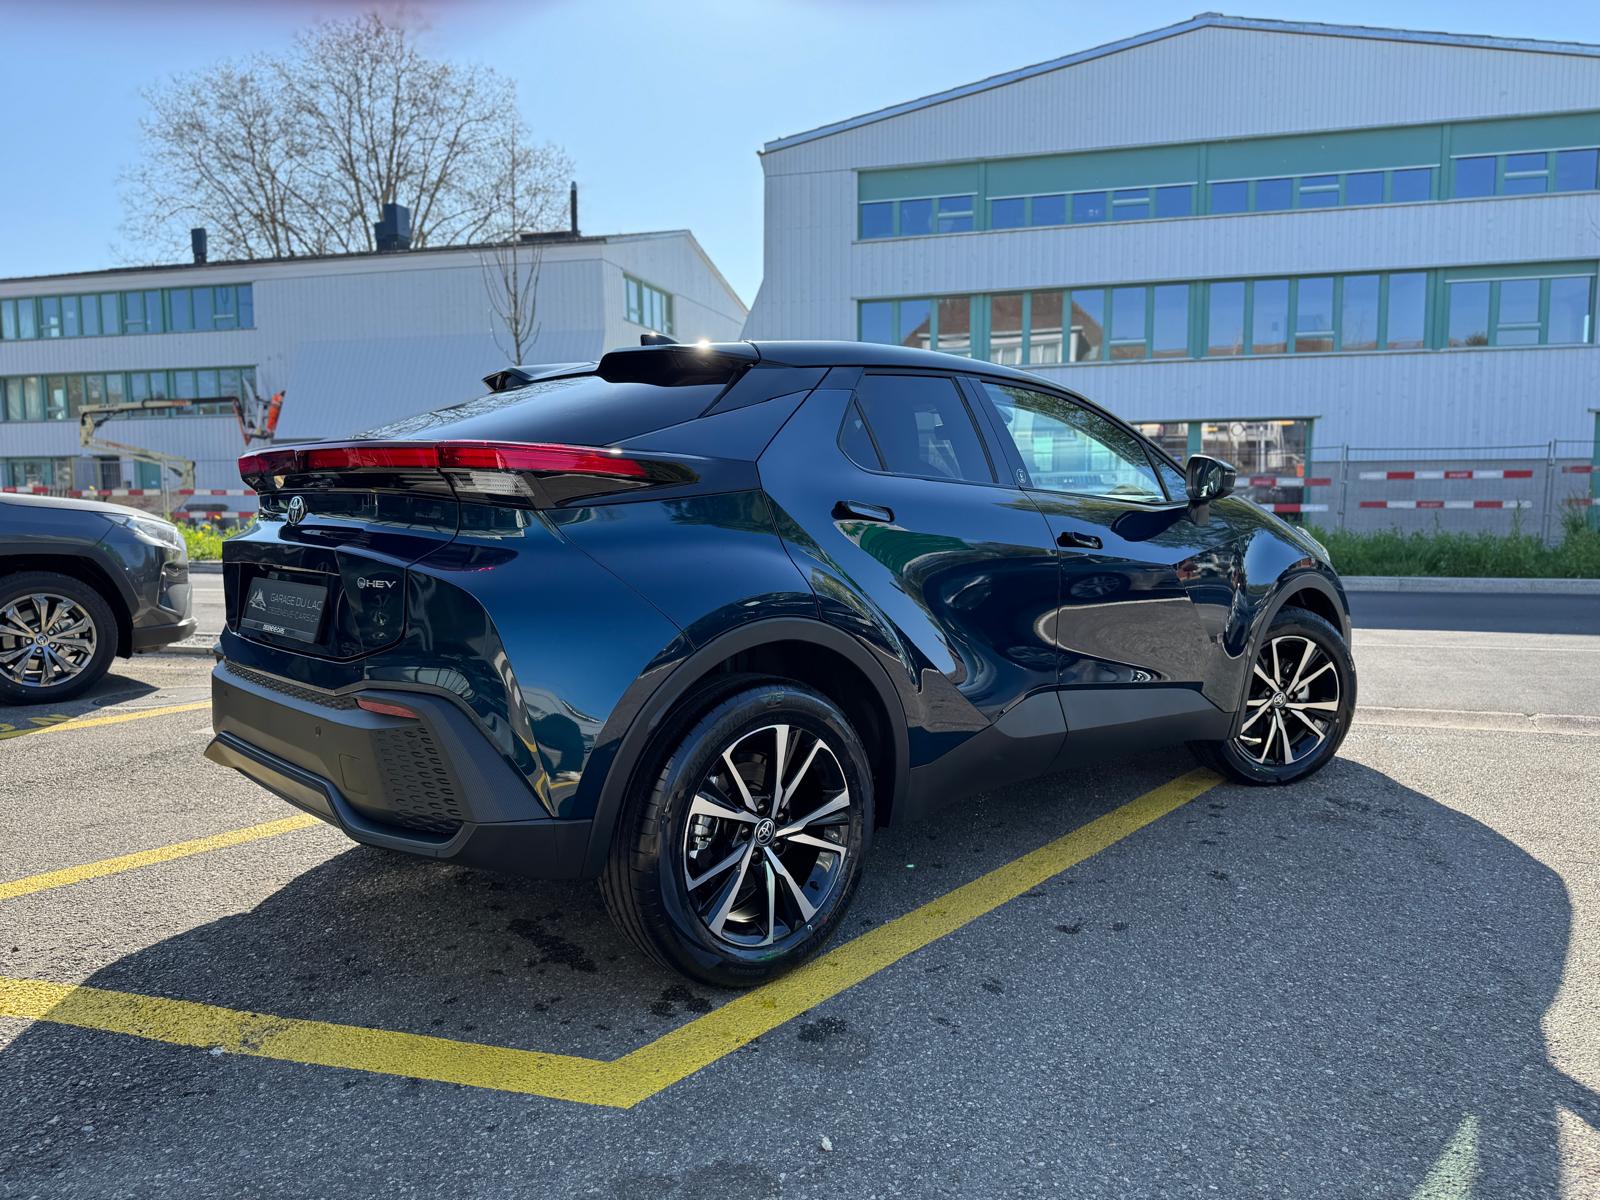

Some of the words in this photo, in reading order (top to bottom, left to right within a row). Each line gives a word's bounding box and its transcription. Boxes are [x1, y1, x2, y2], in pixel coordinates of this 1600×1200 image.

[366, 579, 397, 589] HEV
[270, 593, 296, 606] GARAGE
[296, 597, 307, 608] DU
[307, 600, 324, 611] LAC
